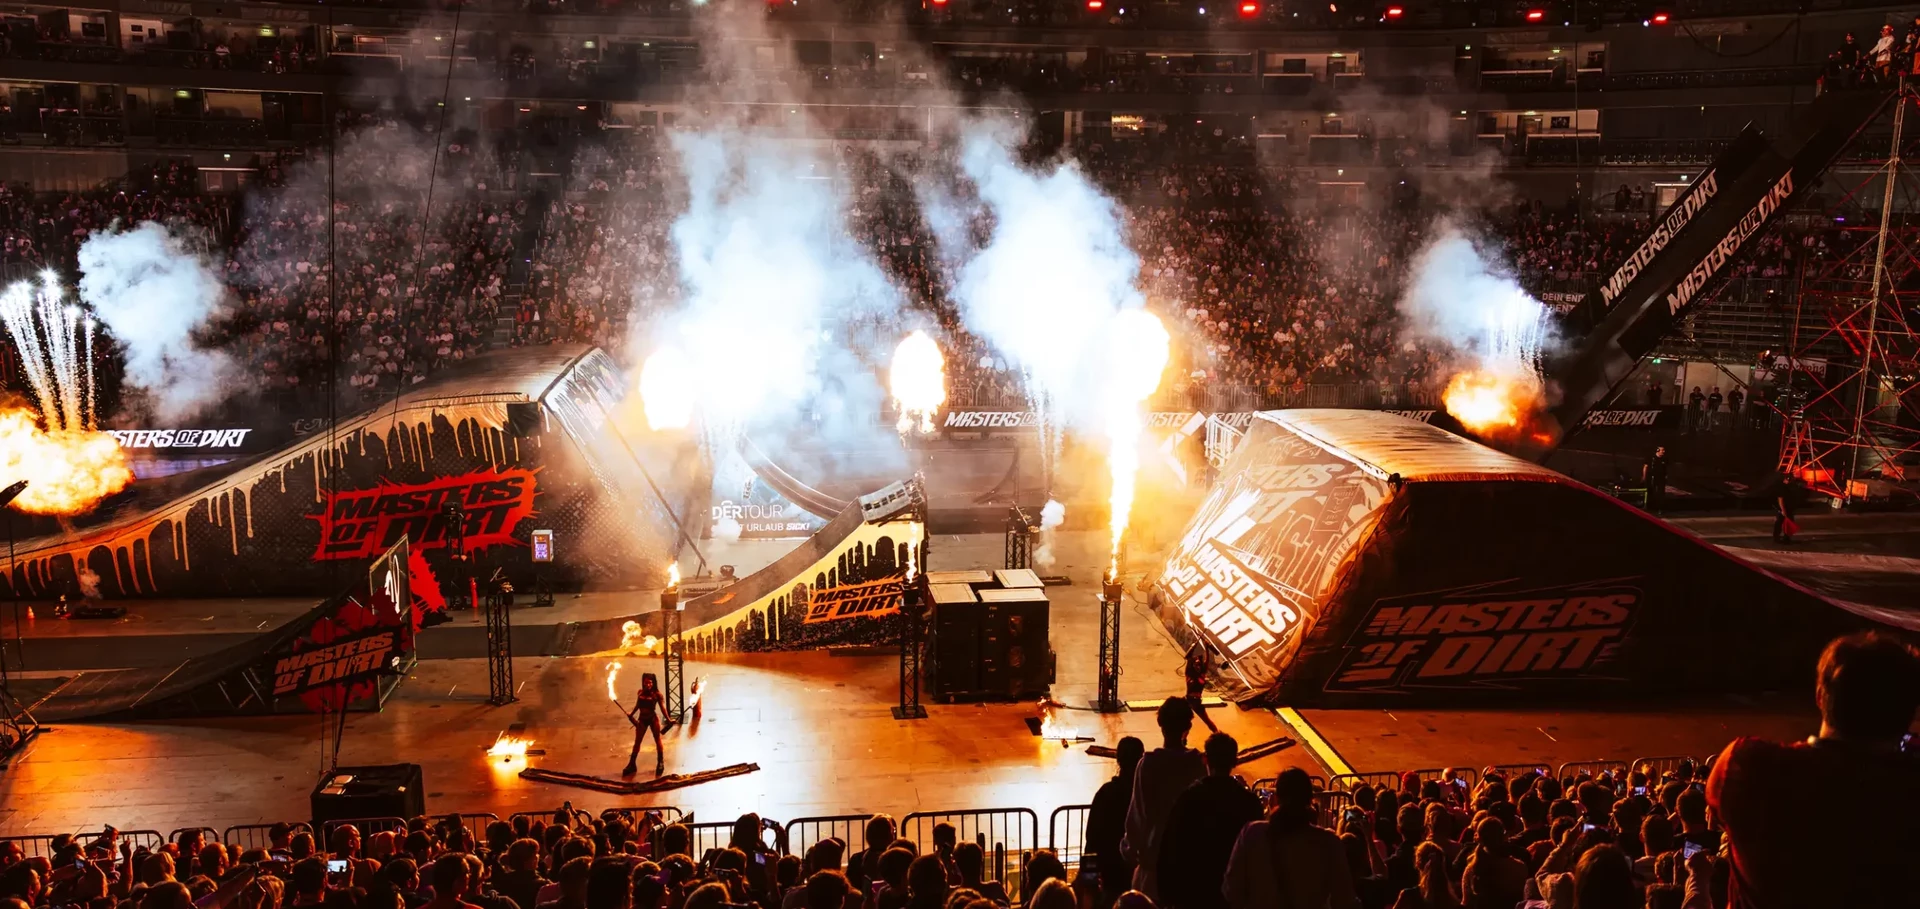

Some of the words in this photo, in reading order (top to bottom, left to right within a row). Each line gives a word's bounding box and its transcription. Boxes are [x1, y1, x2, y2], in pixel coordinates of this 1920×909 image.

[1601, 223, 1671, 306] MASTERS
[1667, 206, 1688, 238] OF
[1684, 168, 1718, 221] DIRT
[1667, 226, 1741, 316] MASTERS
[1739, 207, 1760, 242] OF
[1758, 167, 1794, 223] DIRT
[1542, 292, 1563, 301] DEIN
[944, 411, 1021, 427] MASTERS
[1020, 412, 1038, 427] O
[1223, 412, 1252, 427] DIR
[1622, 410, 1662, 425] DIRT
[173, 430, 202, 448] OF
[199, 428, 252, 448] DIRT
[331, 477, 526, 521] MASTERS
[712, 502, 783, 519] DERTOUR
[328, 523, 377, 545] OF
[747, 523, 784, 531] URLAUB
[1179, 565, 1205, 590] OF
[1193, 543, 1297, 634] MASTERS
[814, 583, 902, 603] MASTERS
[811, 603, 837, 616] OF
[836, 594, 900, 615] DIRT
[1363, 594, 1636, 635] MASTERS
[275, 632, 394, 674] MASTERS
[1416, 629, 1622, 678] DIRT
[275, 670, 305, 689] OF
[308, 647, 392, 687] DIRT
